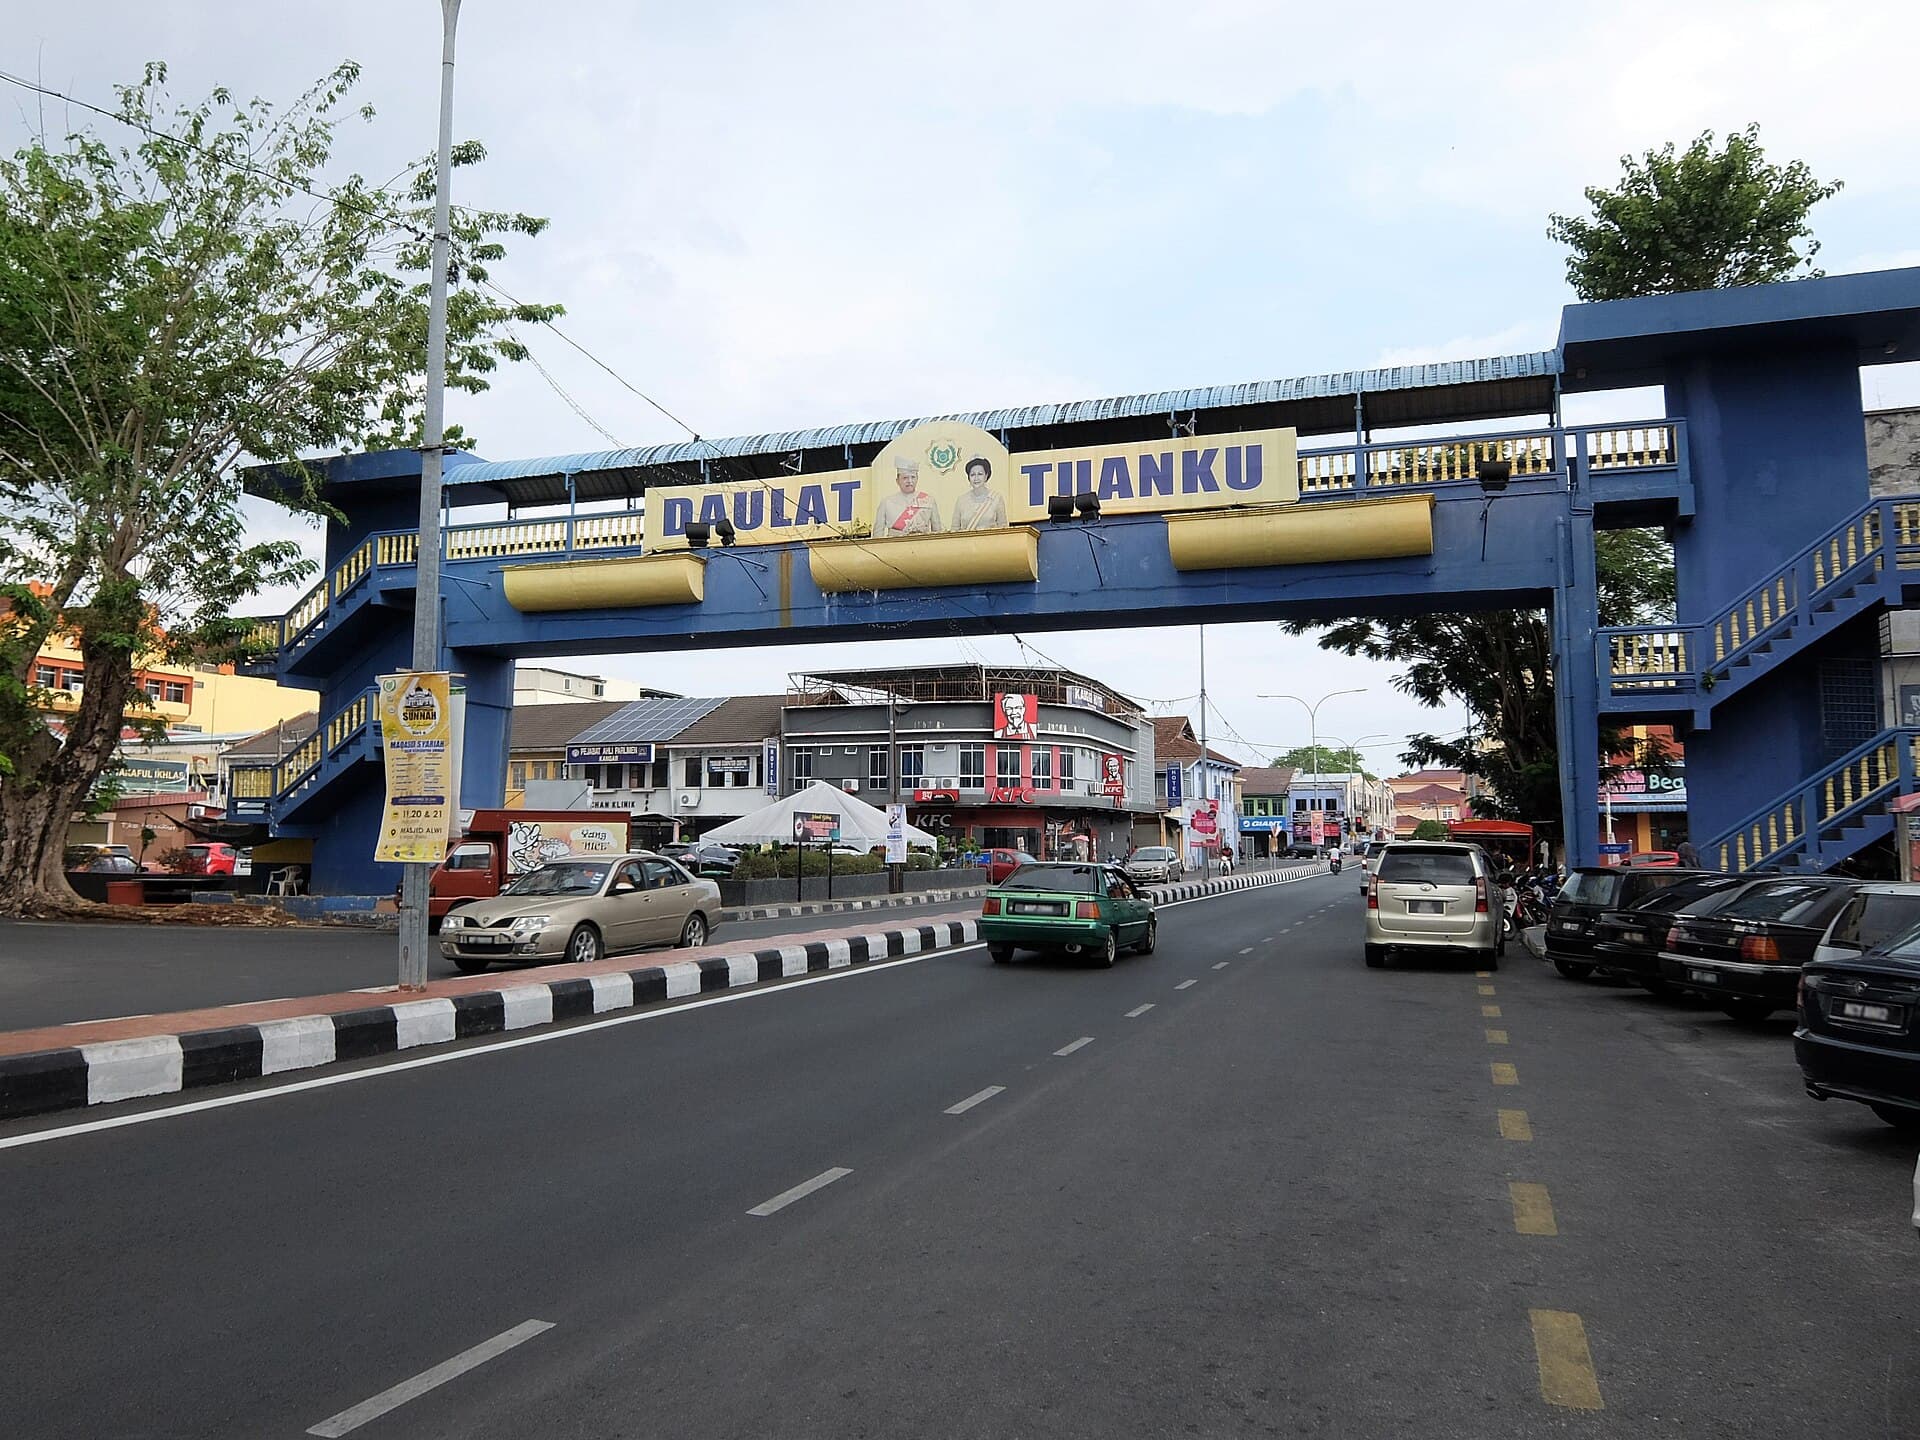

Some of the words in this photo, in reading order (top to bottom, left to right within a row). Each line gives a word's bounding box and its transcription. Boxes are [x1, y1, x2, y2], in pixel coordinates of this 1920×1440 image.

[663, 481, 861, 536] DAULAT
[1020, 444, 1263, 506] TUANKU
[403, 711, 436, 720] SUNNAH
[990, 787, 1036, 803] KFC
[433, 810, 442, 818] 21
[914, 814, 951, 827] KFC
[1251, 821, 1282, 829] GIANT
[581, 830, 606, 840] Yang
